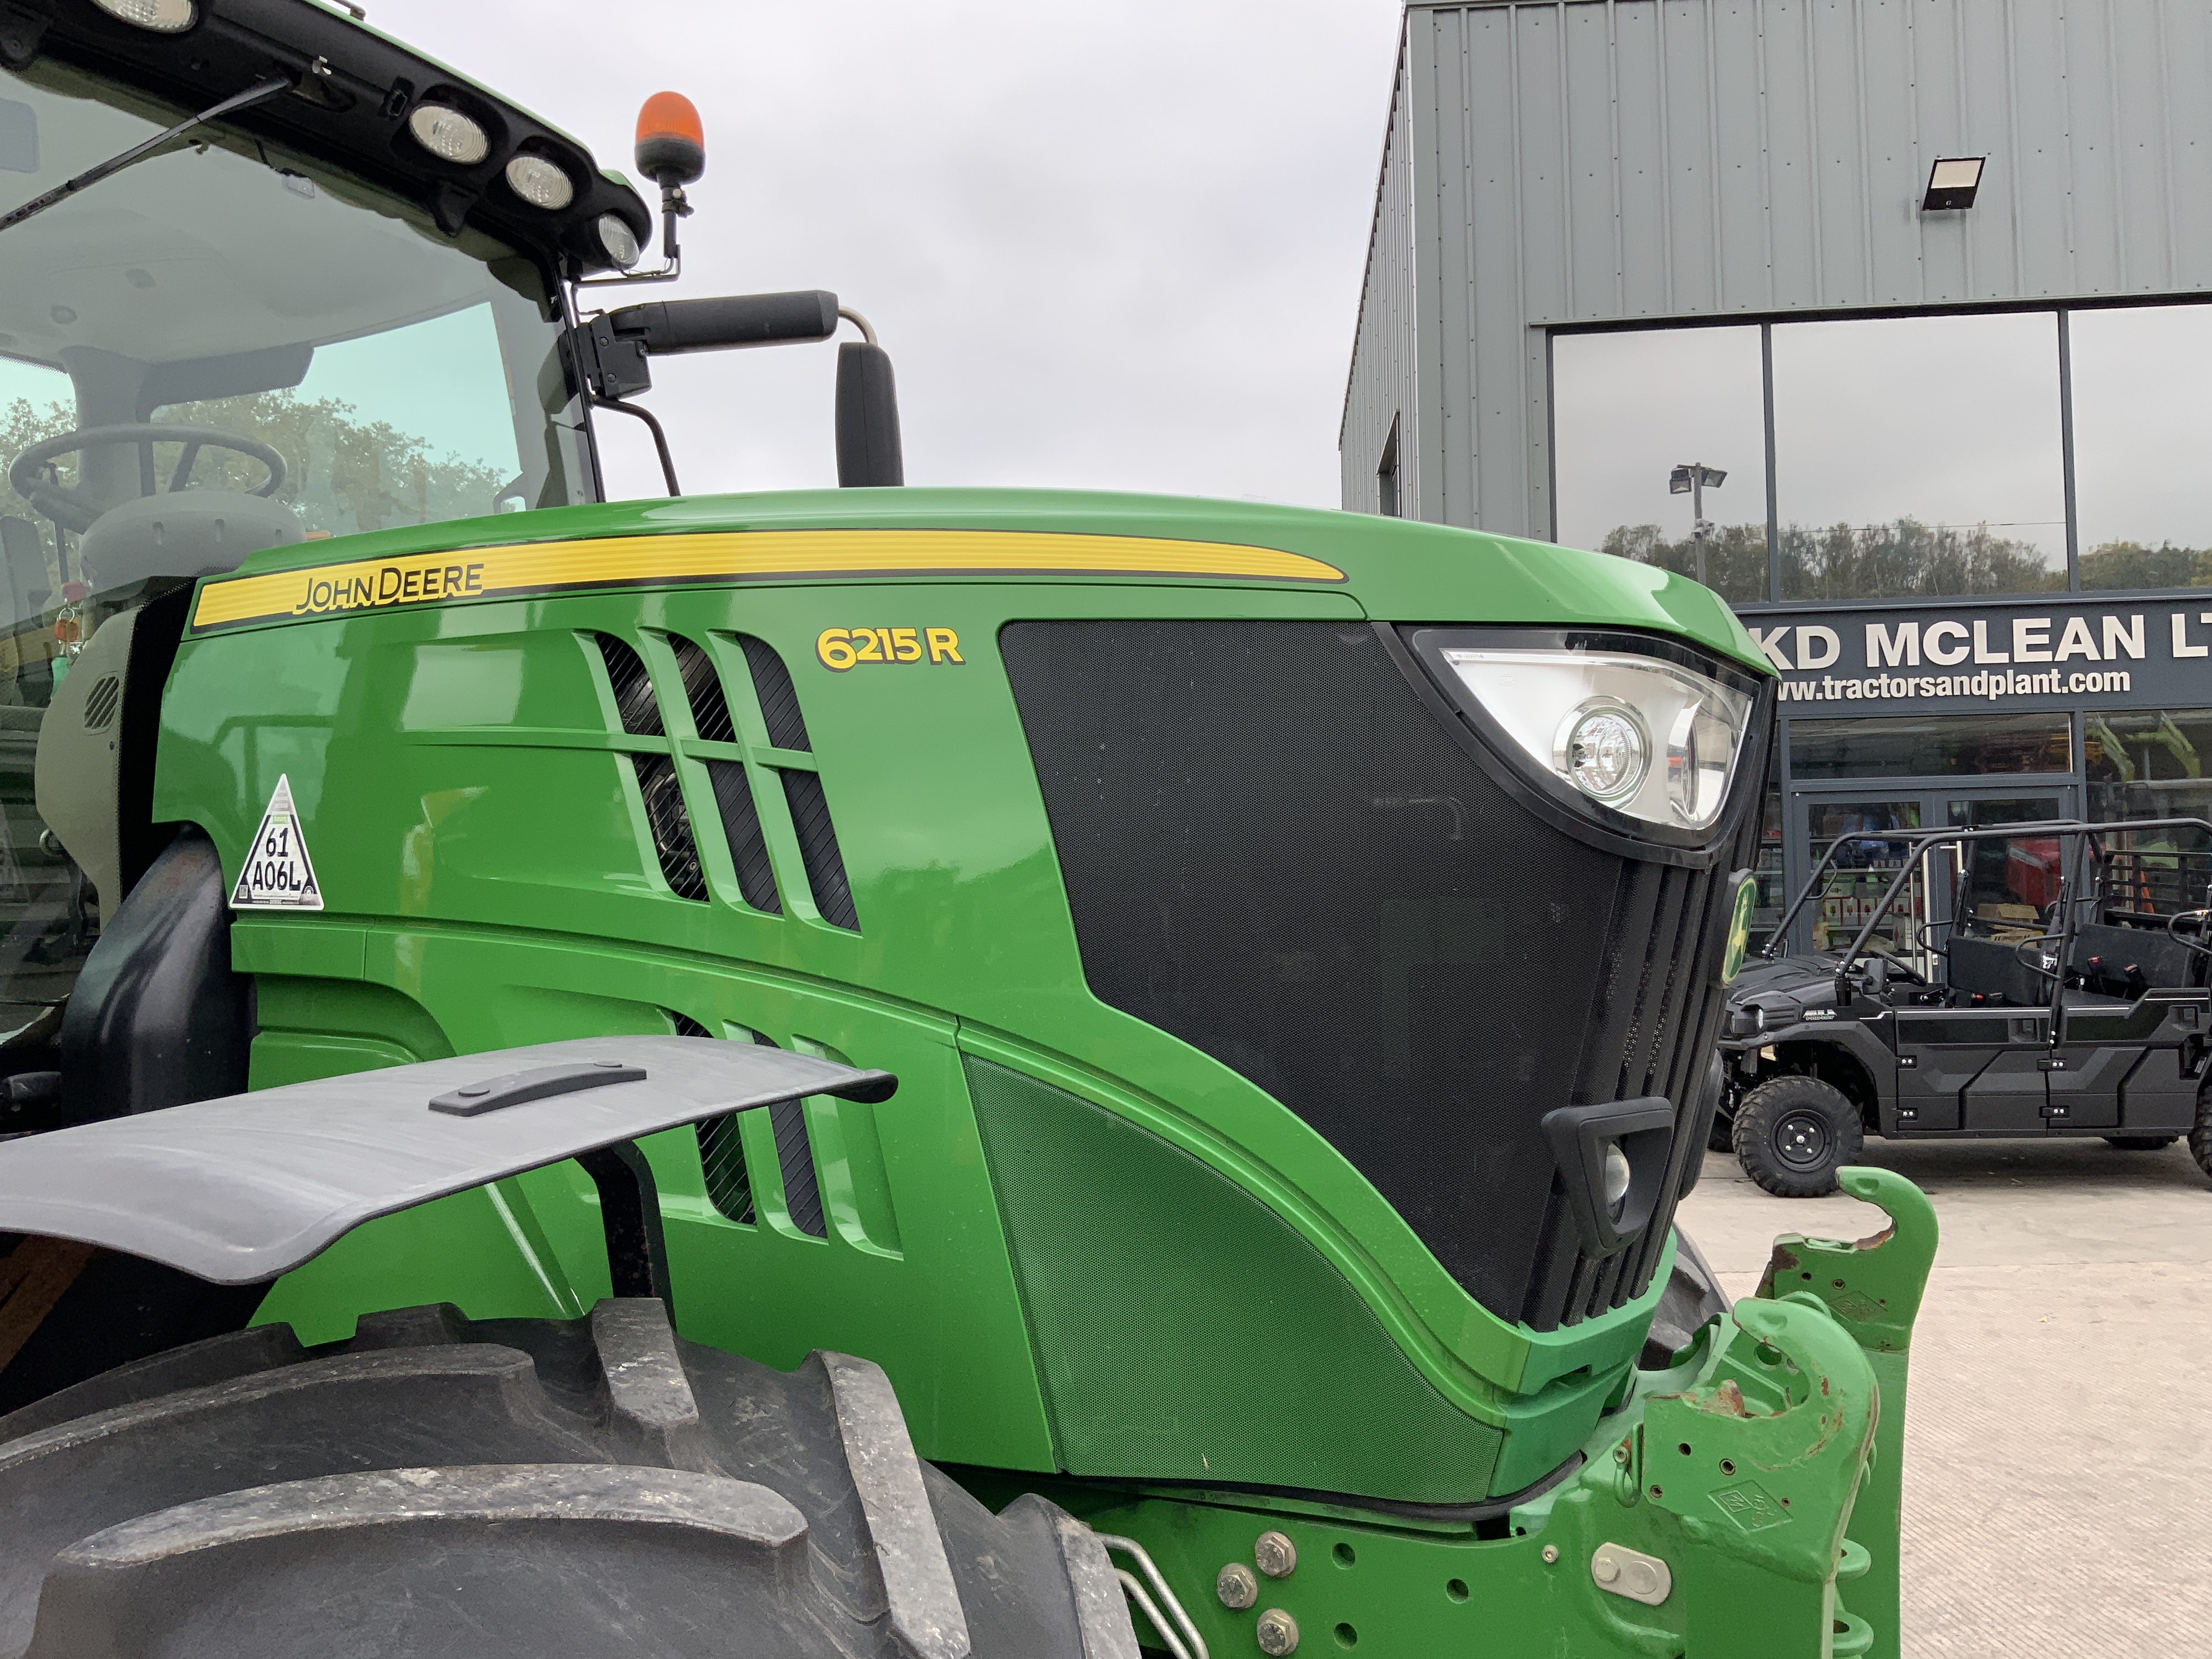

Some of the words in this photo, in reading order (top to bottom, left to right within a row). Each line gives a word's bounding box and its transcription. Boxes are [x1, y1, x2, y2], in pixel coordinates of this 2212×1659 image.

[295, 575, 374, 611] JOHN
[378, 563, 485, 601] DEERE
[1748, 625, 1841, 670] KD
[1865, 614, 2146, 668] MCLEAN
[2171, 612, 2212, 658] L
[265, 827, 289, 857] 61
[252, 861, 302, 891] A06L
